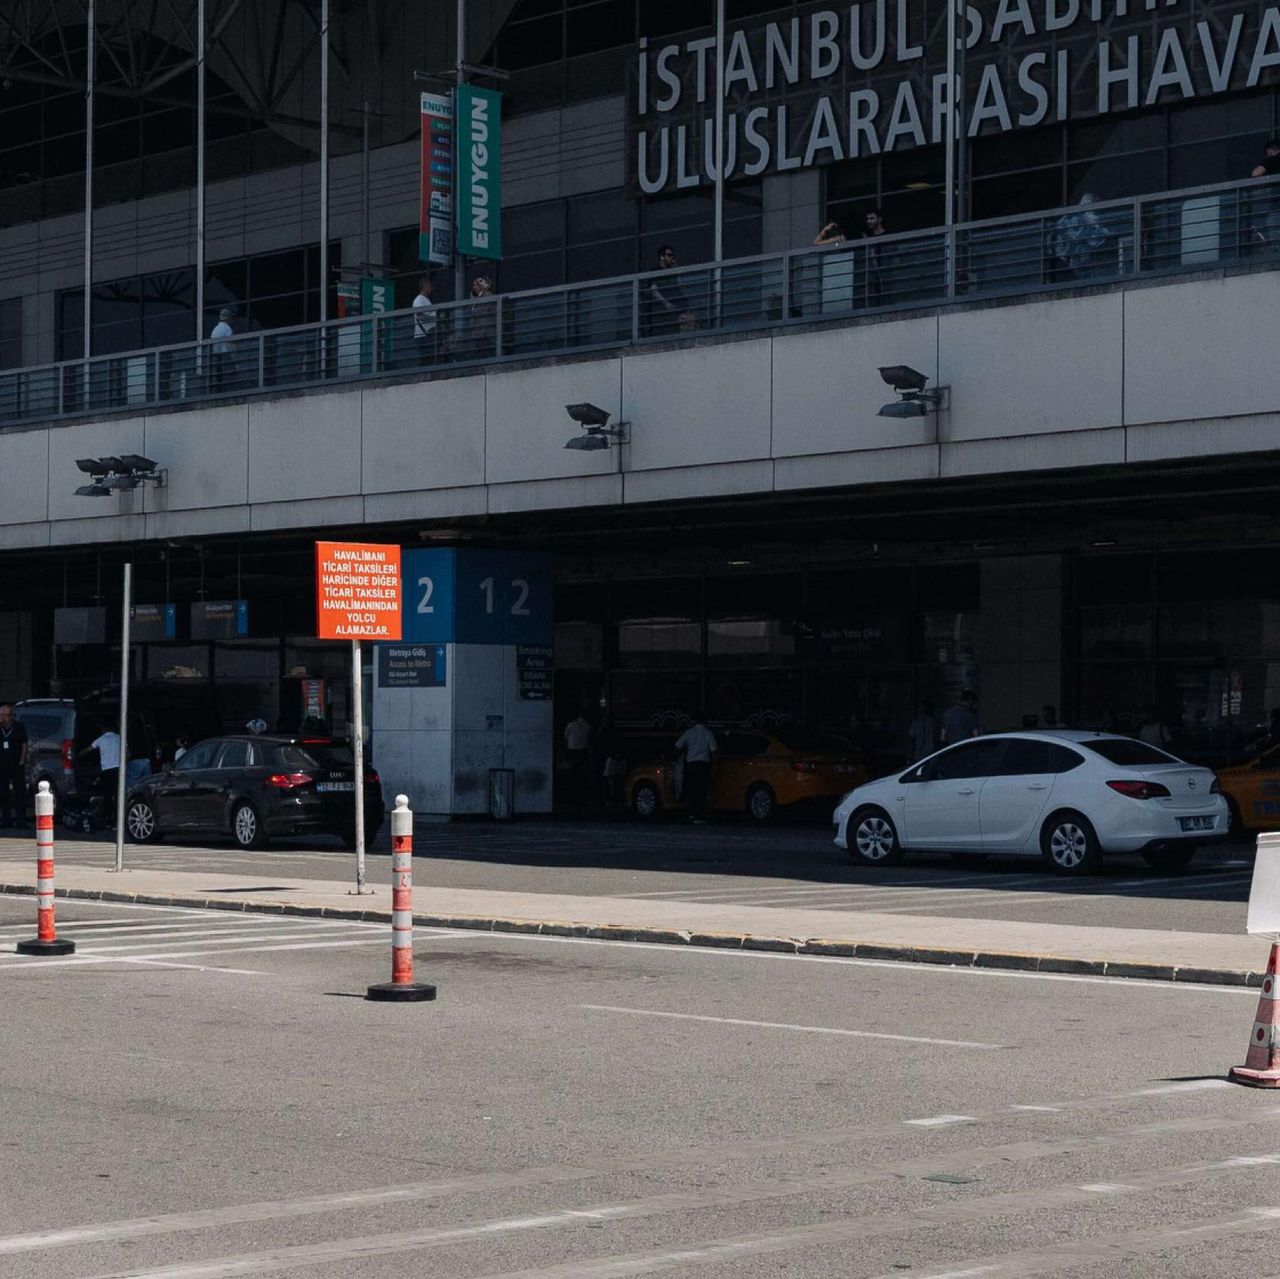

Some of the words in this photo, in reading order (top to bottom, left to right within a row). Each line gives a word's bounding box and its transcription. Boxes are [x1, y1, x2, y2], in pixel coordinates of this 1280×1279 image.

[637, 50, 1069, 195] ULUSLARARASI
[472, 96, 488, 249] ENUYGUN
[334, 549, 386, 562] HAVALİMANI
[323, 561, 351, 573] TİCARİ
[354, 563, 397, 574] TAKSİLERİ
[322, 574, 369, 586] HARİCİNDE
[372, 574, 398, 587] DİĞER
[325, 586, 353, 597] TİCARİ
[355, 587, 396, 599] TAKSİLER
[416, 577, 434, 614] 2
[323, 599, 398, 610] HAVALİMANINDAN
[347, 613, 376, 623] YOLCU
[389, 648, 411, 659] Metroya
